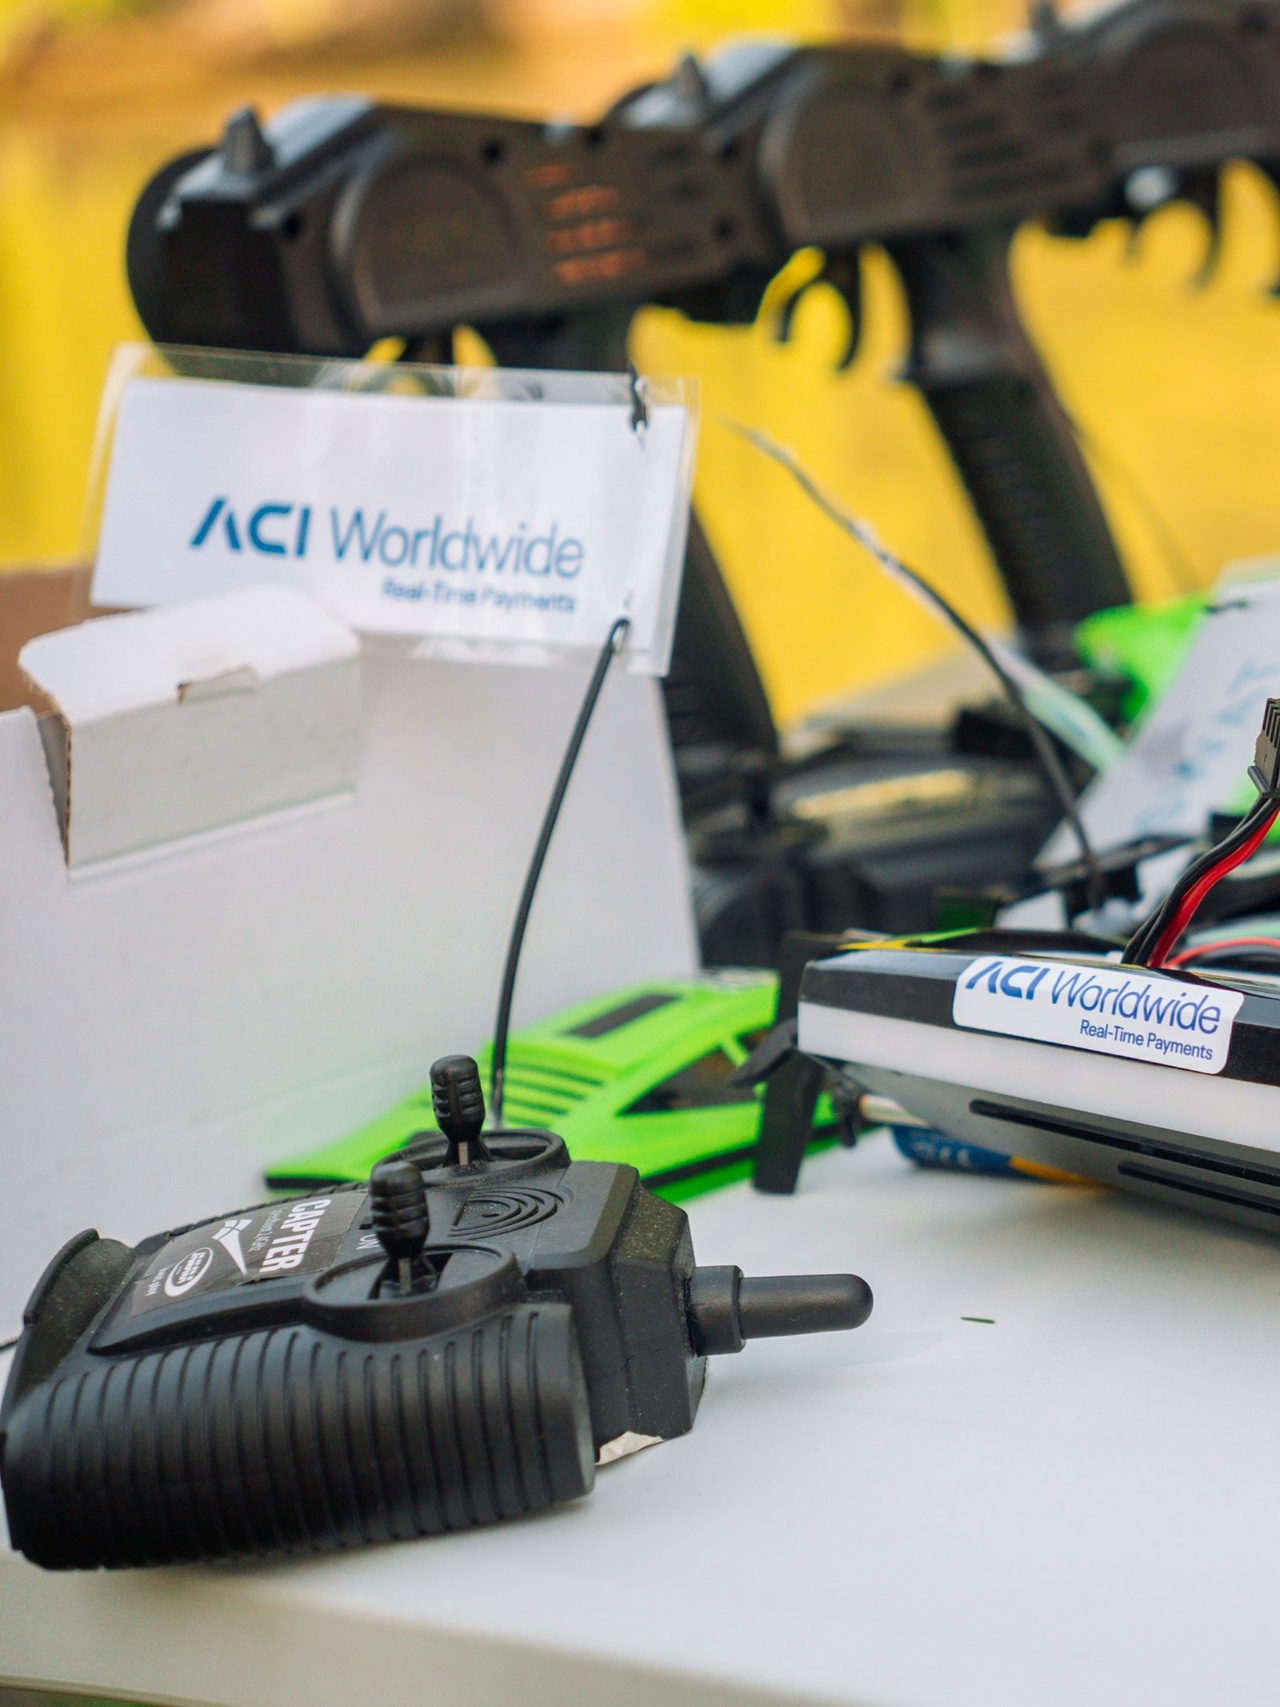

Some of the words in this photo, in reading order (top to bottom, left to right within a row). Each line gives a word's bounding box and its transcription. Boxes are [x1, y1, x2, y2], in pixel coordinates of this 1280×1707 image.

[190, 496, 312, 558] ACI
[328, 506, 585, 579] Worldwide
[381, 579, 478, 604] Real-Time
[482, 585, 576, 614] Payments
[965, 961, 1051, 1000] ACI
[1051, 970, 1221, 1034] Worldwide
[1080, 1019, 1144, 1046] Real-Time
[1147, 1033, 1213, 1061] Payments
[259, 1199, 331, 1273] CAPTER
